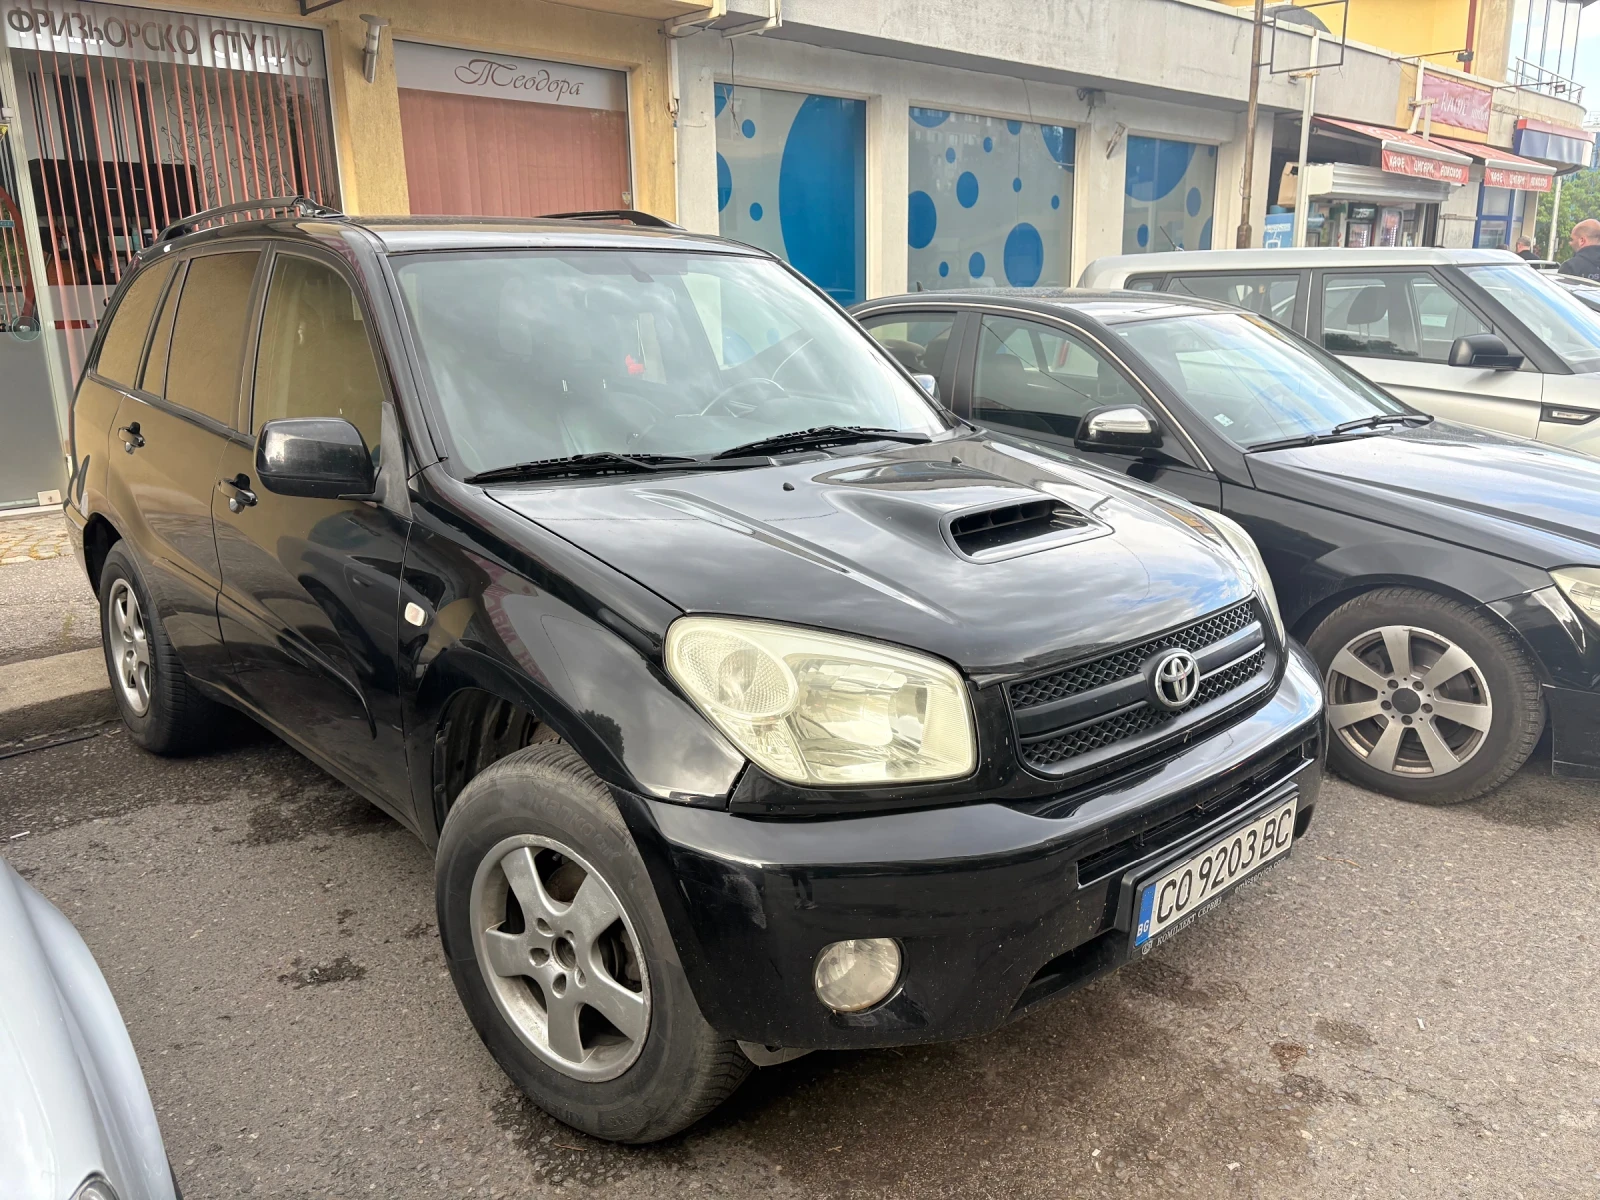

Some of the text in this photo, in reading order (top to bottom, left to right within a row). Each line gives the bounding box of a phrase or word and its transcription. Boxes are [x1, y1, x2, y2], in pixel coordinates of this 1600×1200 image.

[7, 7, 313, 67] ФРИЗЬОРСКО СТУДИО
[454, 58, 584, 102] Теодора
[1389, 155, 1405, 169] КАФЕ
[1198, 829, 1258, 898] 9203
[1260, 807, 1292, 860] BC
[1136, 919, 1150, 937] BG
